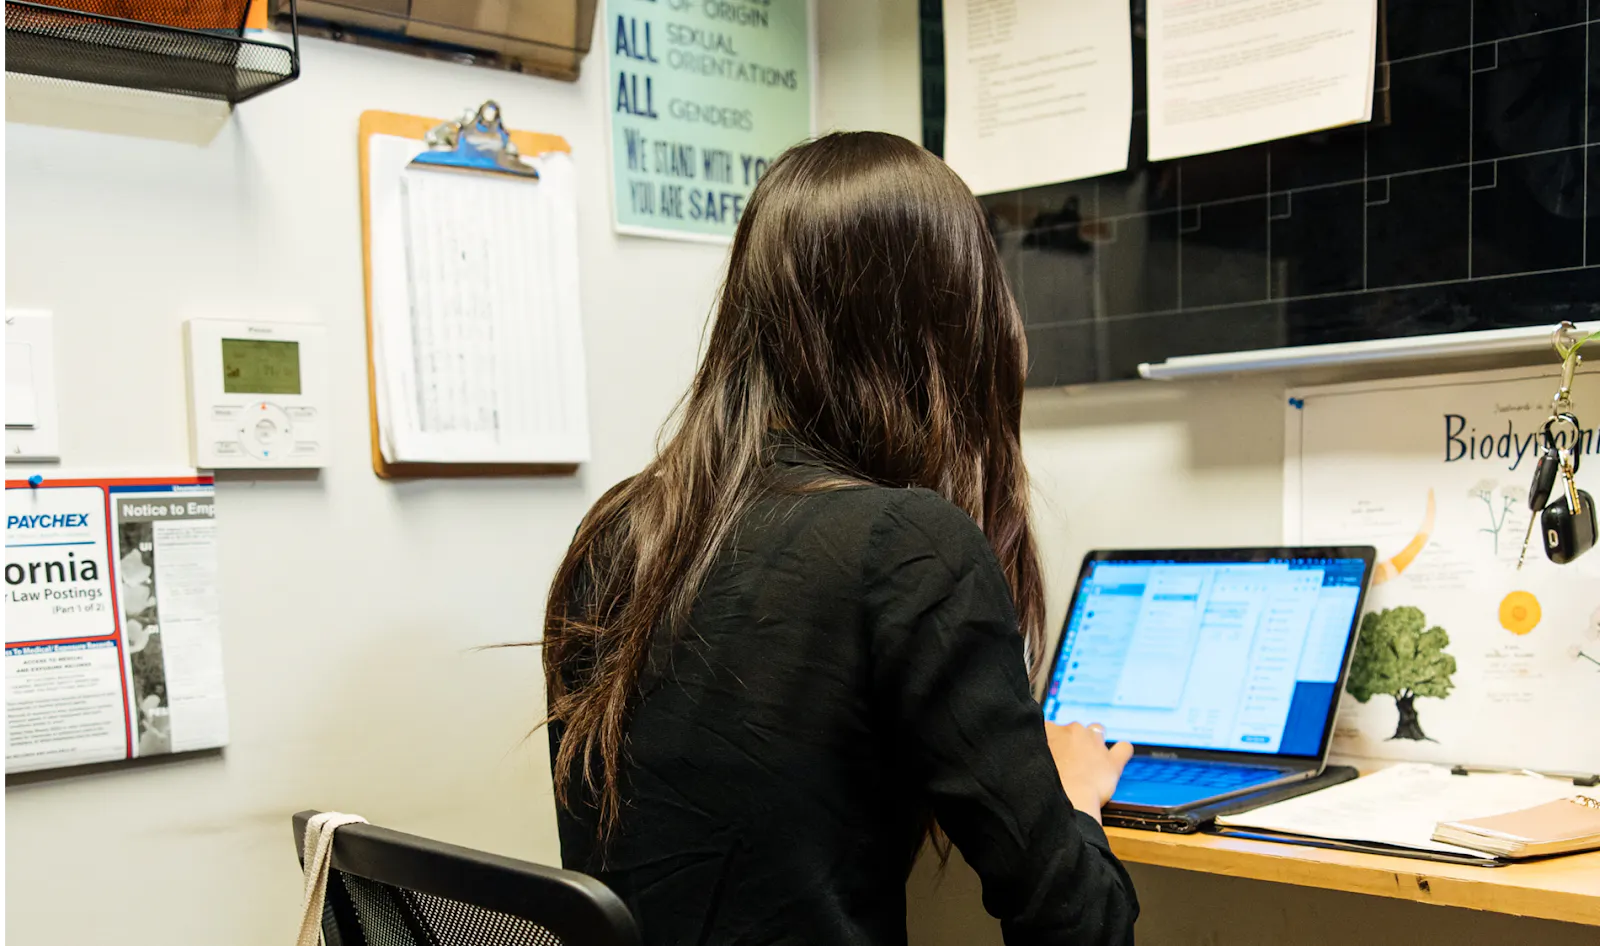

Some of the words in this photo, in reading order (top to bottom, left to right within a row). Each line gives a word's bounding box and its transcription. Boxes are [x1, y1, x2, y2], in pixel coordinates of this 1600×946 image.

[702, 1, 770, 28] ORIGIN
[615, 14, 658, 63] ALL
[666, 22, 738, 56] SEXUAL
[666, 48, 798, 91] ORIENTATIONS
[616, 71, 658, 119] ALL
[668, 96, 754, 131] GENDERS
[654, 139, 697, 180] STAND
[702, 147, 734, 185] WITH
[629, 177, 656, 215] YOU
[660, 183, 685, 221] ARE
[689, 186, 745, 225] SAFE
[7, 513, 90, 529] PAYCHEX
[122, 503, 168, 517] Notice
[169, 503, 185, 516] to
[4, 551, 99, 585] ornia
[12, 590, 40, 602] Law
[44, 586, 103, 602] Postings
[52, 604, 75, 614] (Part
[77, 604, 83, 613] 1
[84, 603, 94, 612] of
[95, 602, 105, 612] 2)
